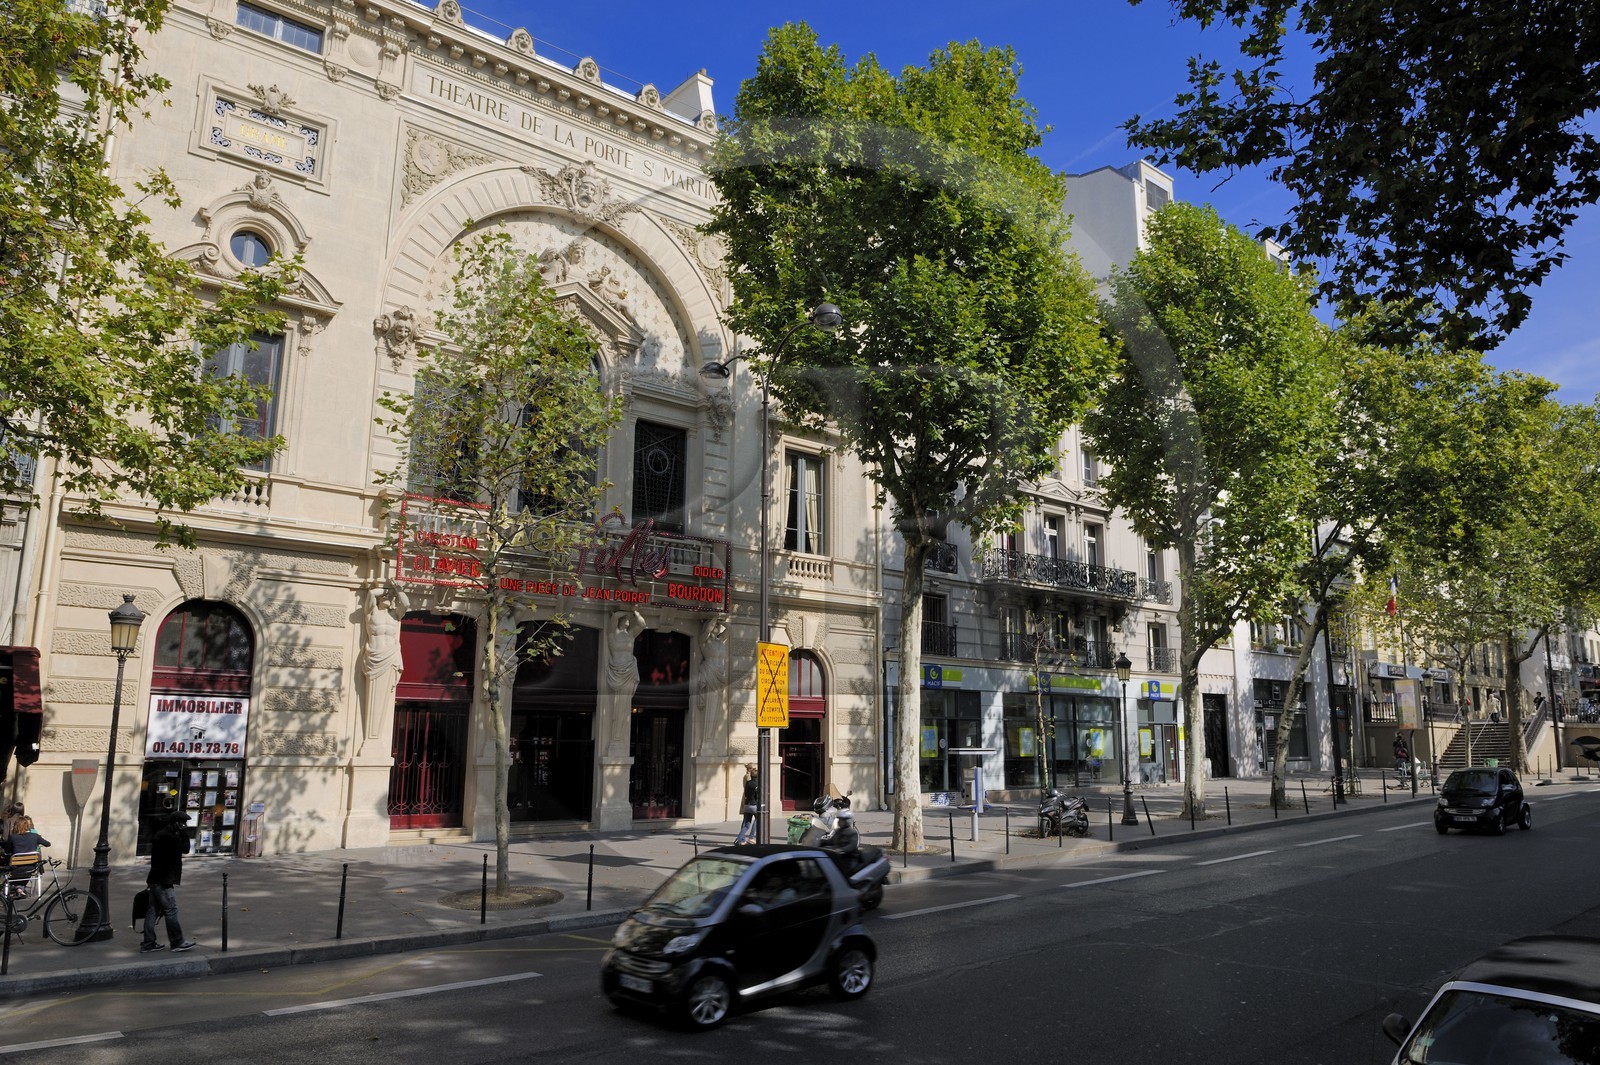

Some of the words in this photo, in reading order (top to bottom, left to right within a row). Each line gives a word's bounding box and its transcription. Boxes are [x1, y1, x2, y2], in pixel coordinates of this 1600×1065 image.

[426, 74, 511, 123] THEATRE
[521, 111, 545, 136] DE
[554, 124, 575, 148] LA
[584, 136, 634, 171] PORTE
[663, 167, 719, 202] MARTIN
[414, 530, 478, 550] CHRISTIAN
[693, 565, 723, 579] DIDIER
[500, 577, 524, 592] UNE
[562, 584, 578, 597] DE
[581, 587, 611, 600] JEAN
[614, 590, 650, 604] POIRET
[668, 583, 723, 604] BOURDON
[156, 698, 243, 715] IMMOBILIER
[152, 741, 239, 754] 01.40.18.78.78
